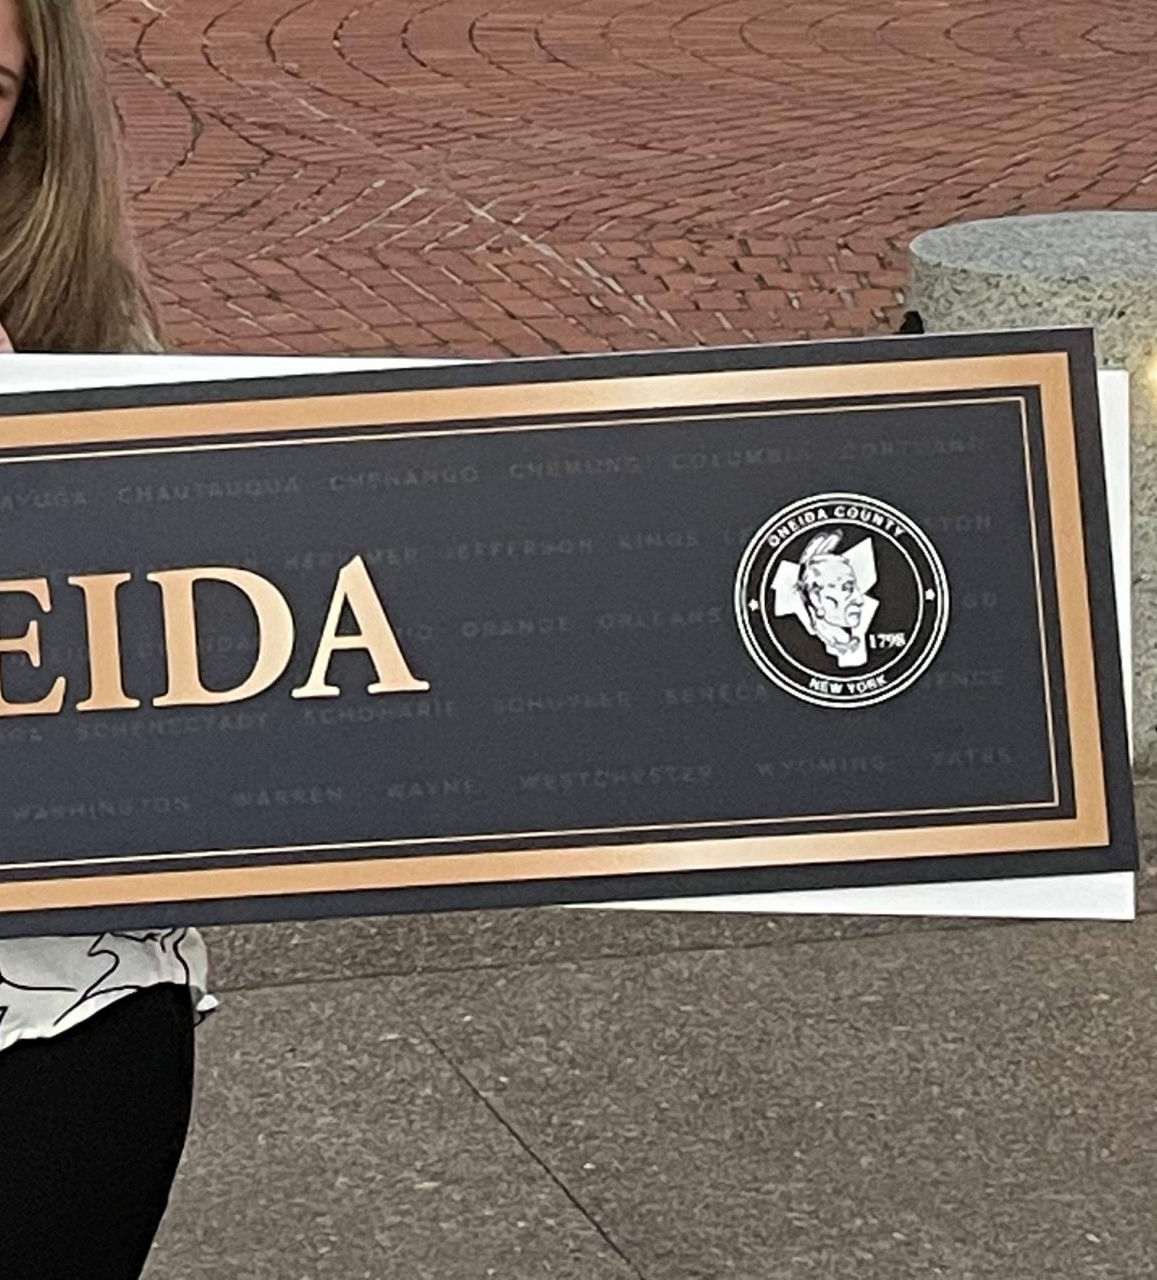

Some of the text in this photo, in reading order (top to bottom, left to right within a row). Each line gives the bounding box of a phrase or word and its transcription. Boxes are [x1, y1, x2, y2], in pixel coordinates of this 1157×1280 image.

[767, 508, 829, 548] ONEIDA
[834, 505, 905, 538] COUNTY
[809, 674, 888, 694] NEW YORK
